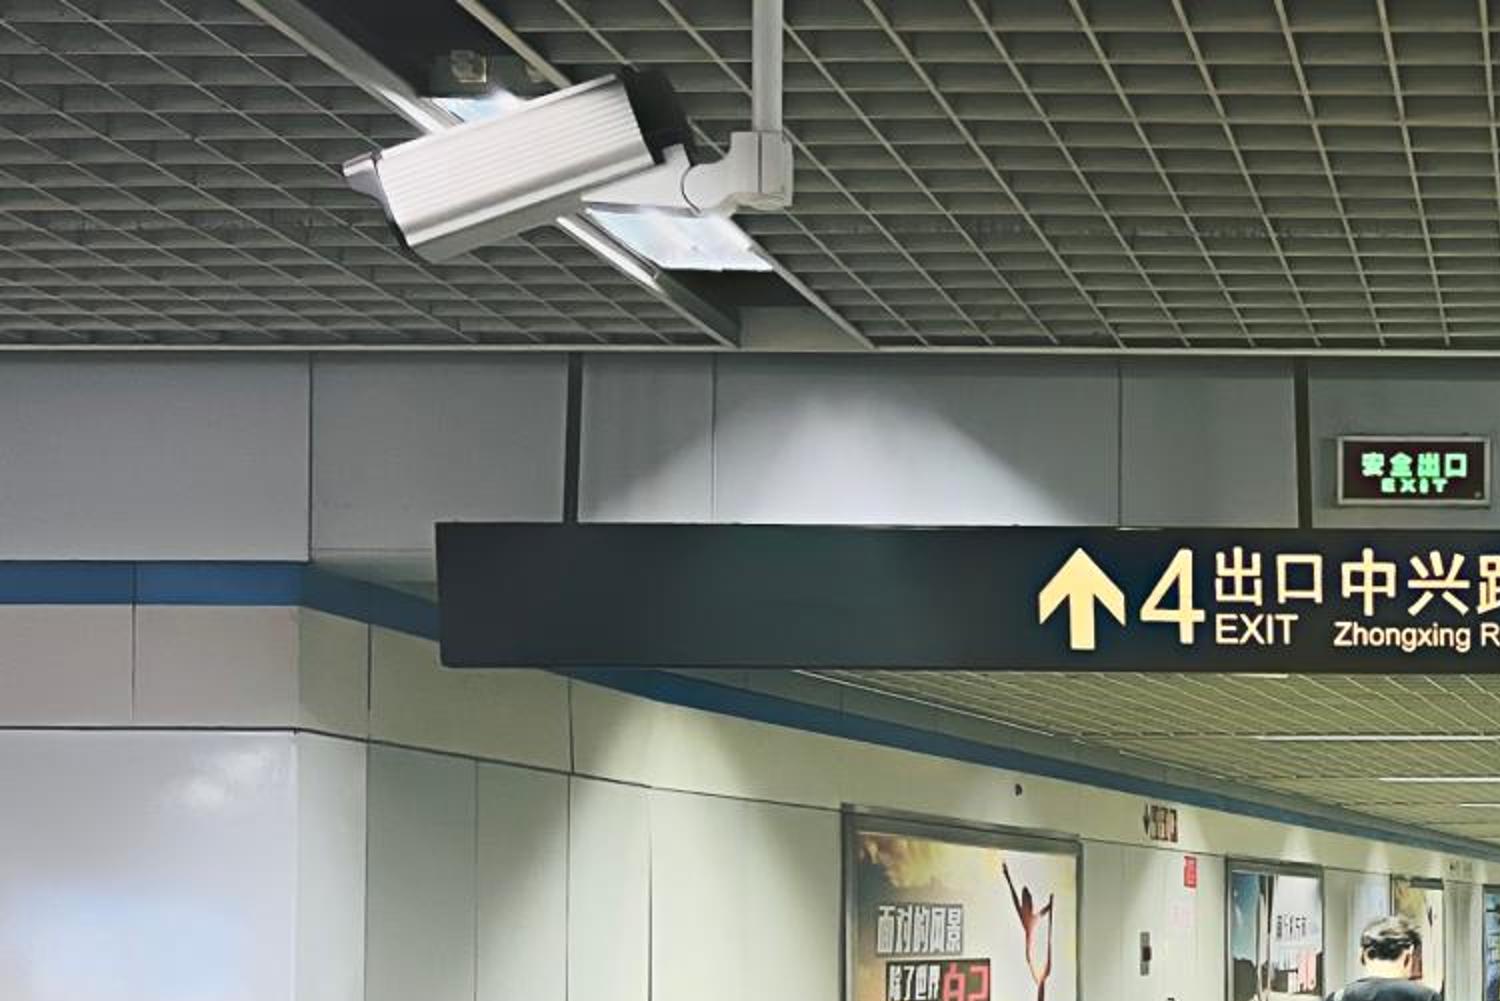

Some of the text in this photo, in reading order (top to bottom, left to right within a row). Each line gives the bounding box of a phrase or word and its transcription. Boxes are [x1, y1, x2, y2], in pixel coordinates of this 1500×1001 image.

[1361, 451, 1468, 478] 安全出口
[1381, 477, 1448, 494] EXIT
[1139, 548, 1205, 645] 4
[1214, 546, 1323, 607] 出口
[1215, 613, 1299, 645] EXIT
[1333, 621, 1471, 653] Zhongxing
